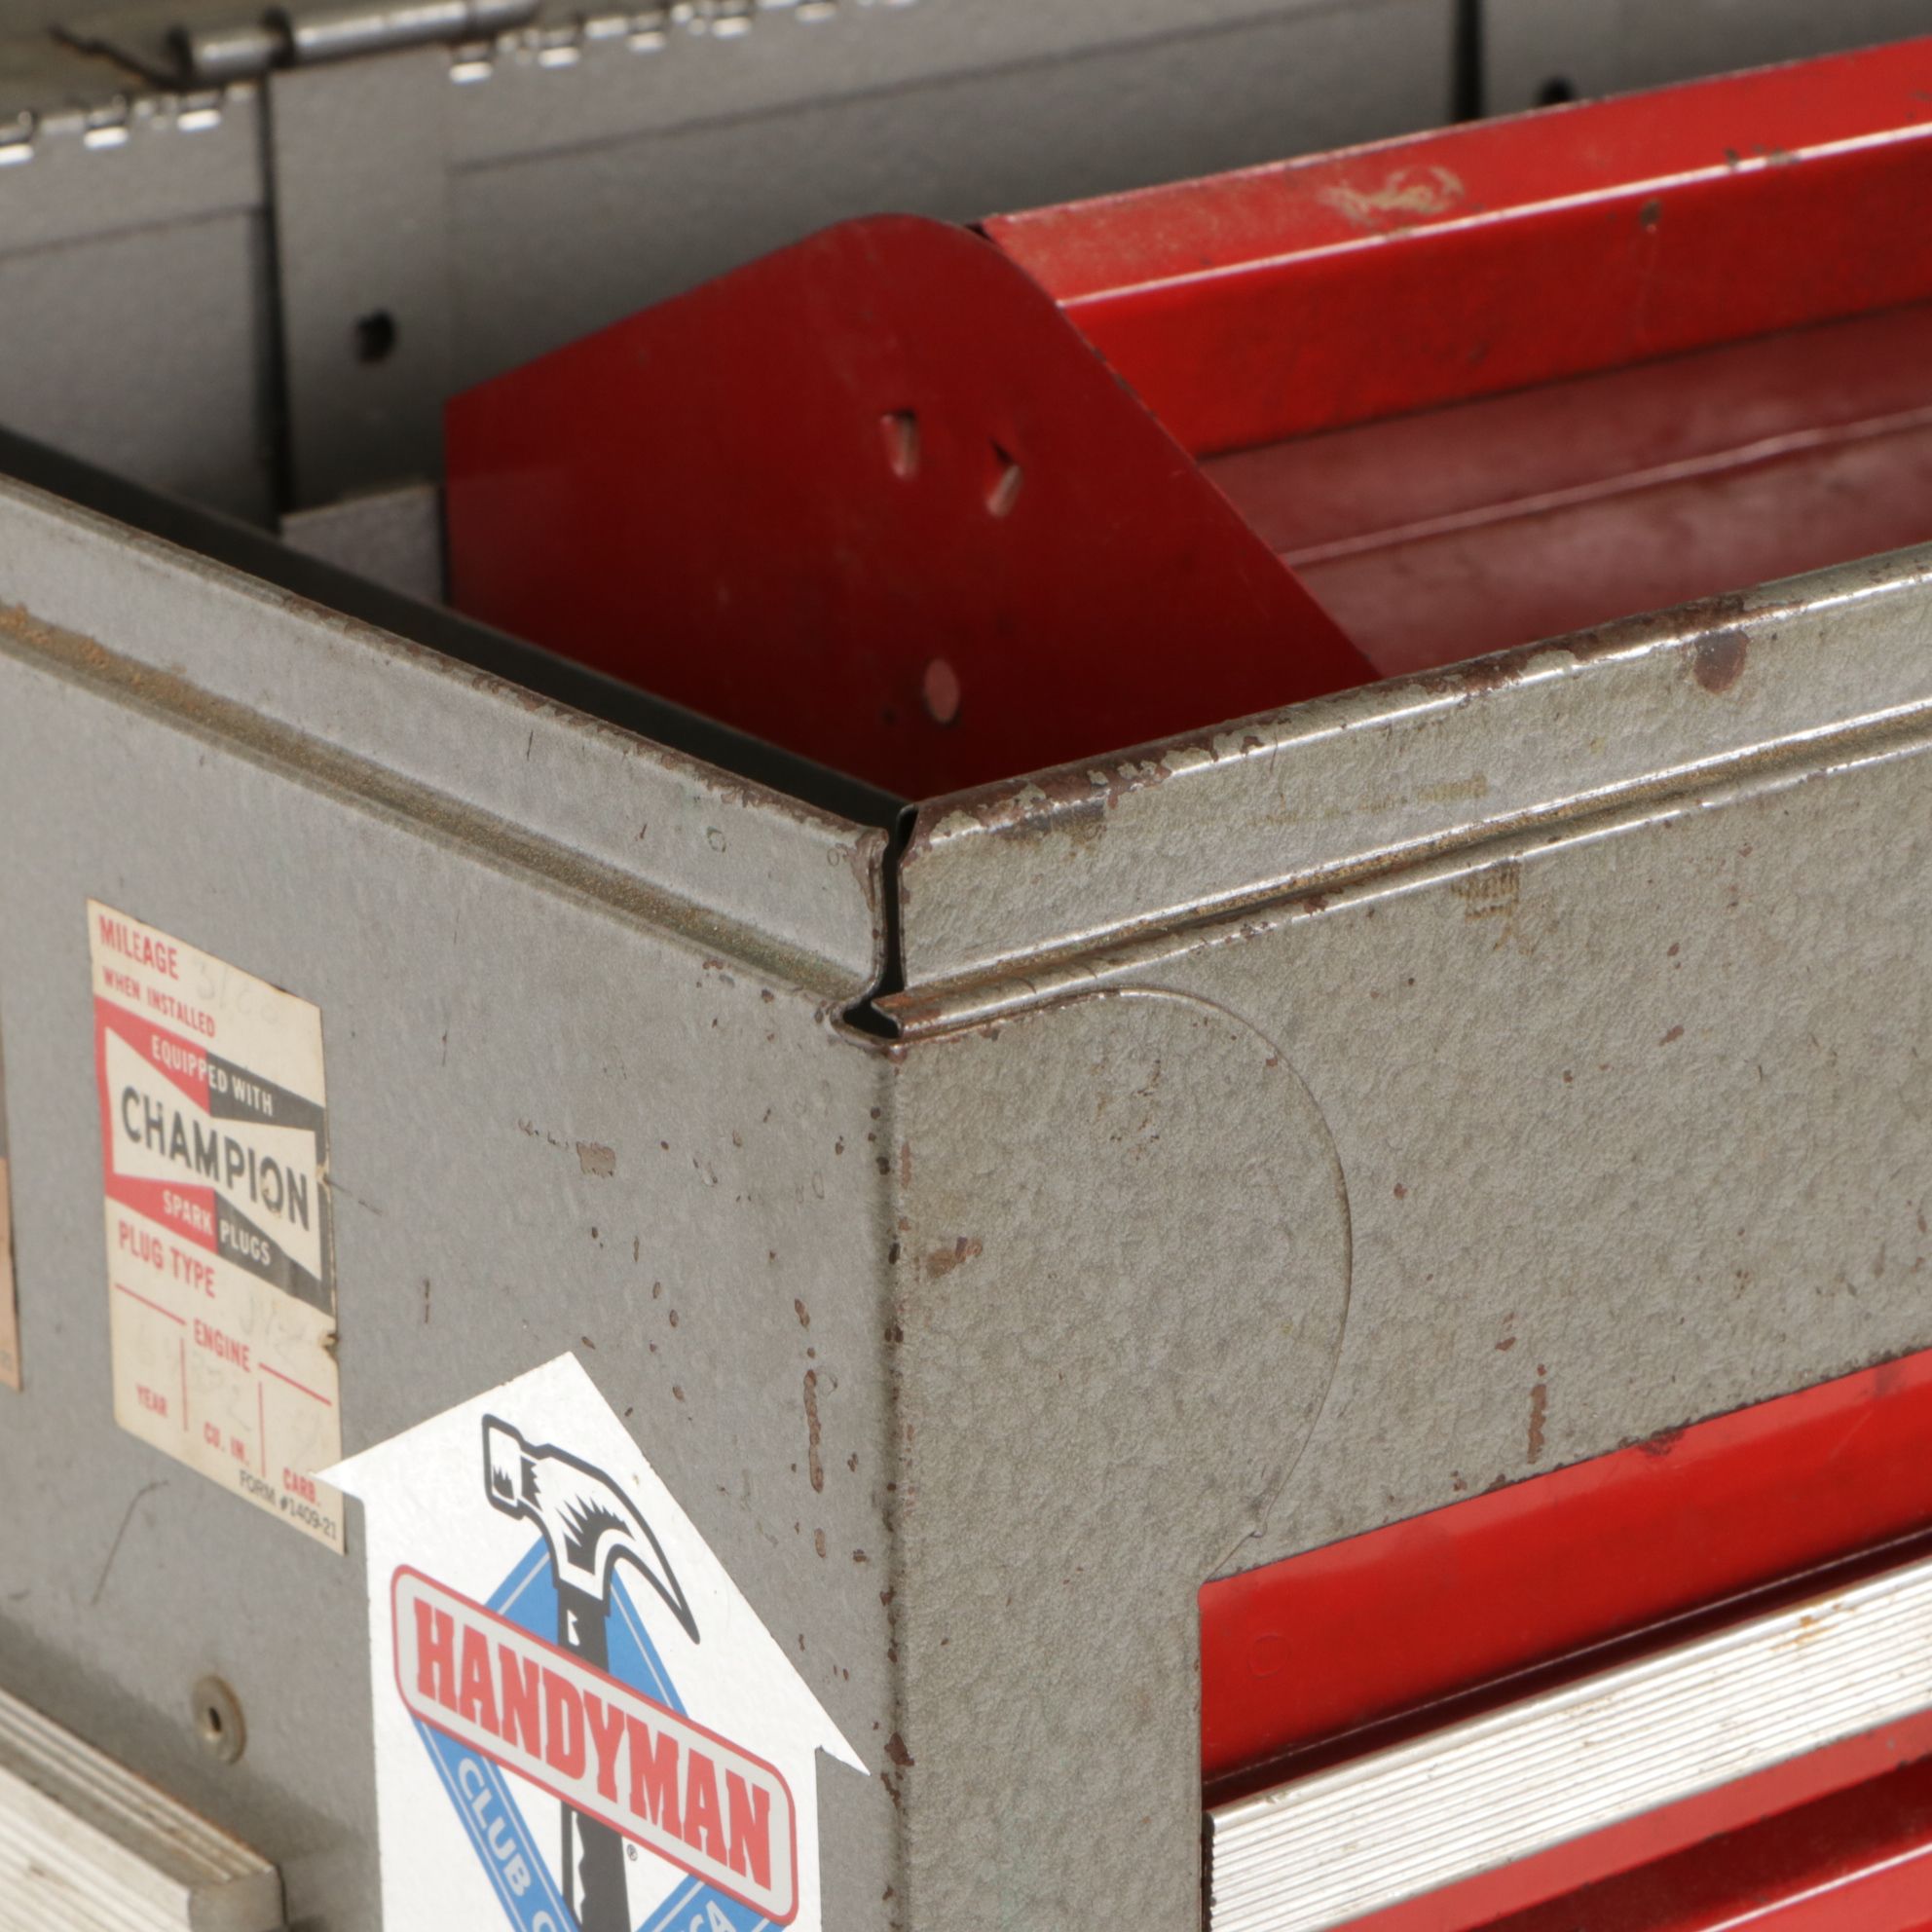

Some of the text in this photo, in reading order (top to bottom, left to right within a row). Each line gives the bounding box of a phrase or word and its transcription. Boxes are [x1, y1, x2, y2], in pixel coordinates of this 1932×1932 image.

[97, 914, 178, 980] MILEAGE
[102, 967, 140, 999] WHEN
[146, 987, 215, 1038] INSTALLED
[152, 1035, 272, 1115] EQUIPPED WITH
[121, 1085, 310, 1231] CHAMPION
[118, 1219, 214, 1298] PLUG TYPE
[163, 1190, 270, 1264] SPARK PLUGS
[193, 1318, 250, 1372] ENGINE
[136, 1385, 167, 1415] YEAR
[240, 1469, 275, 1504] FORM
[413, 1597, 771, 1892] HANDYMAN
[458, 1758, 532, 1896] CLUB
